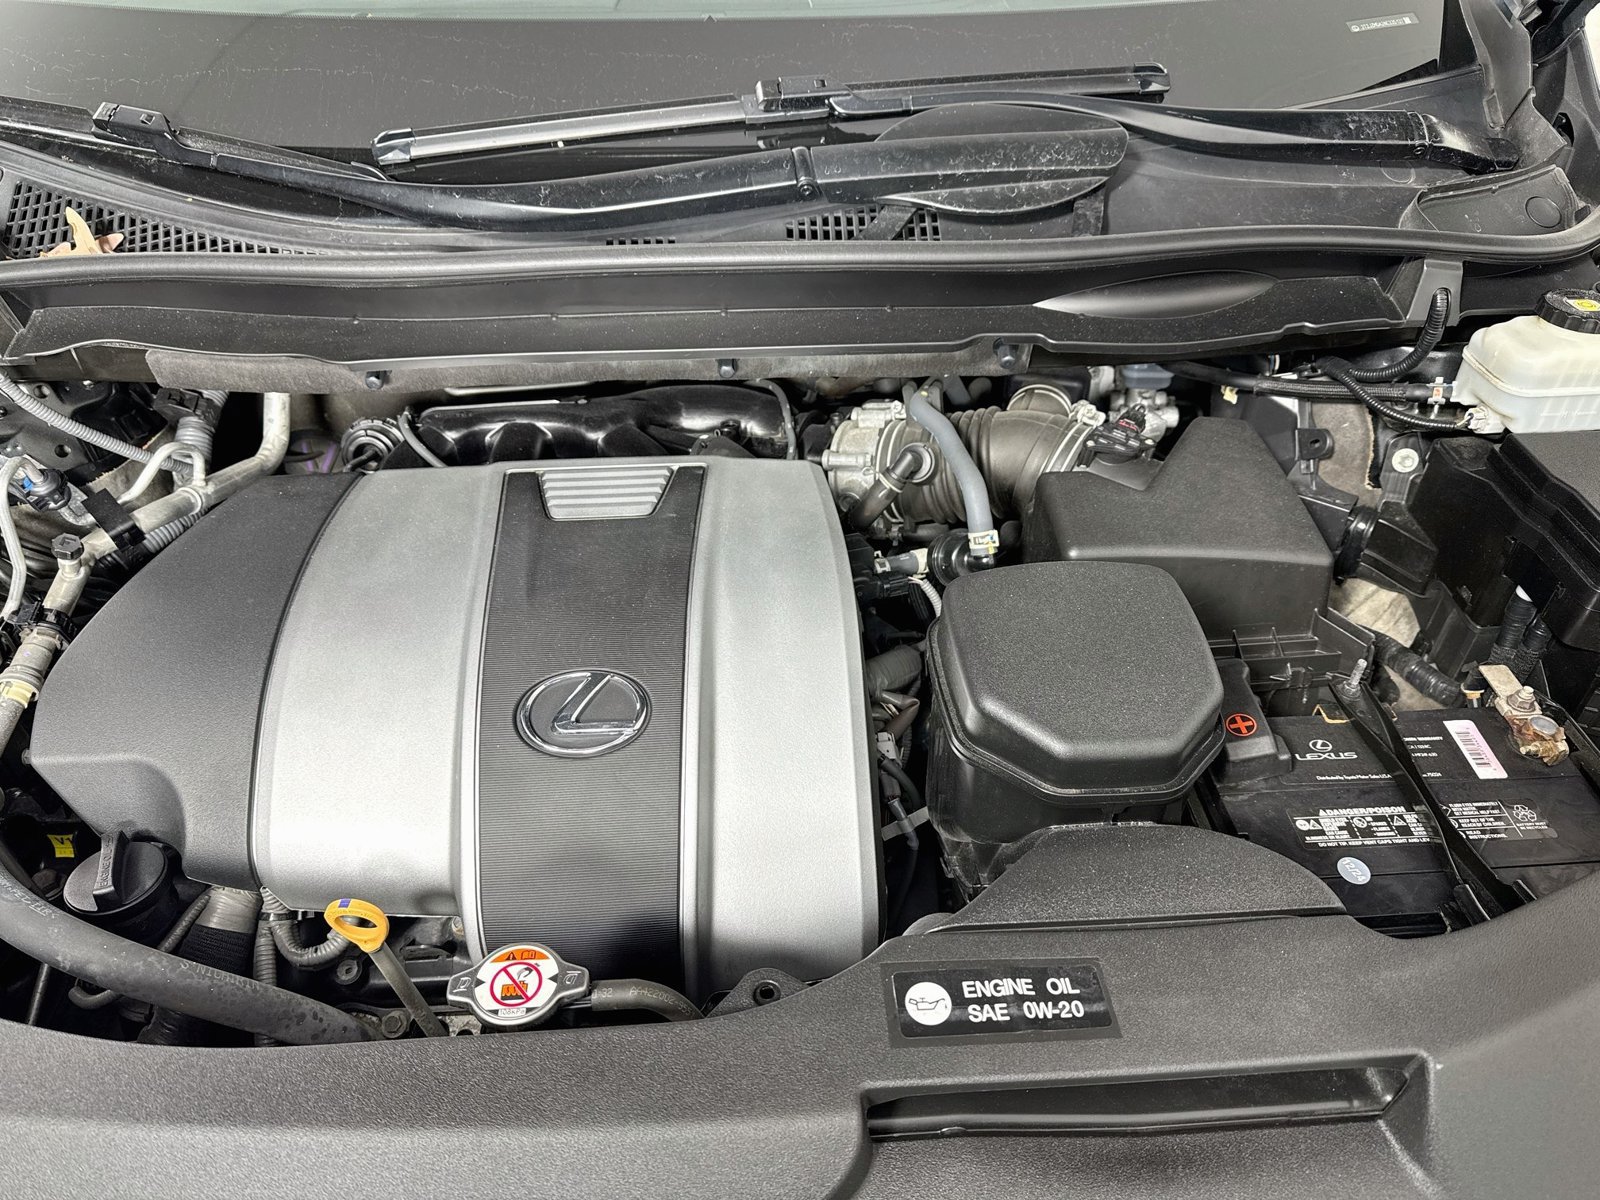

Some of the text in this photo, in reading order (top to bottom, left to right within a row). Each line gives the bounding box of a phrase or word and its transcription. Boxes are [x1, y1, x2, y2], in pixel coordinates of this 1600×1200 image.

[1295, 752, 1358, 761] LEXUS
[962, 977, 1080, 998] ENGINE OIL
[968, 1000, 1085, 1023] SAE 0W-20
